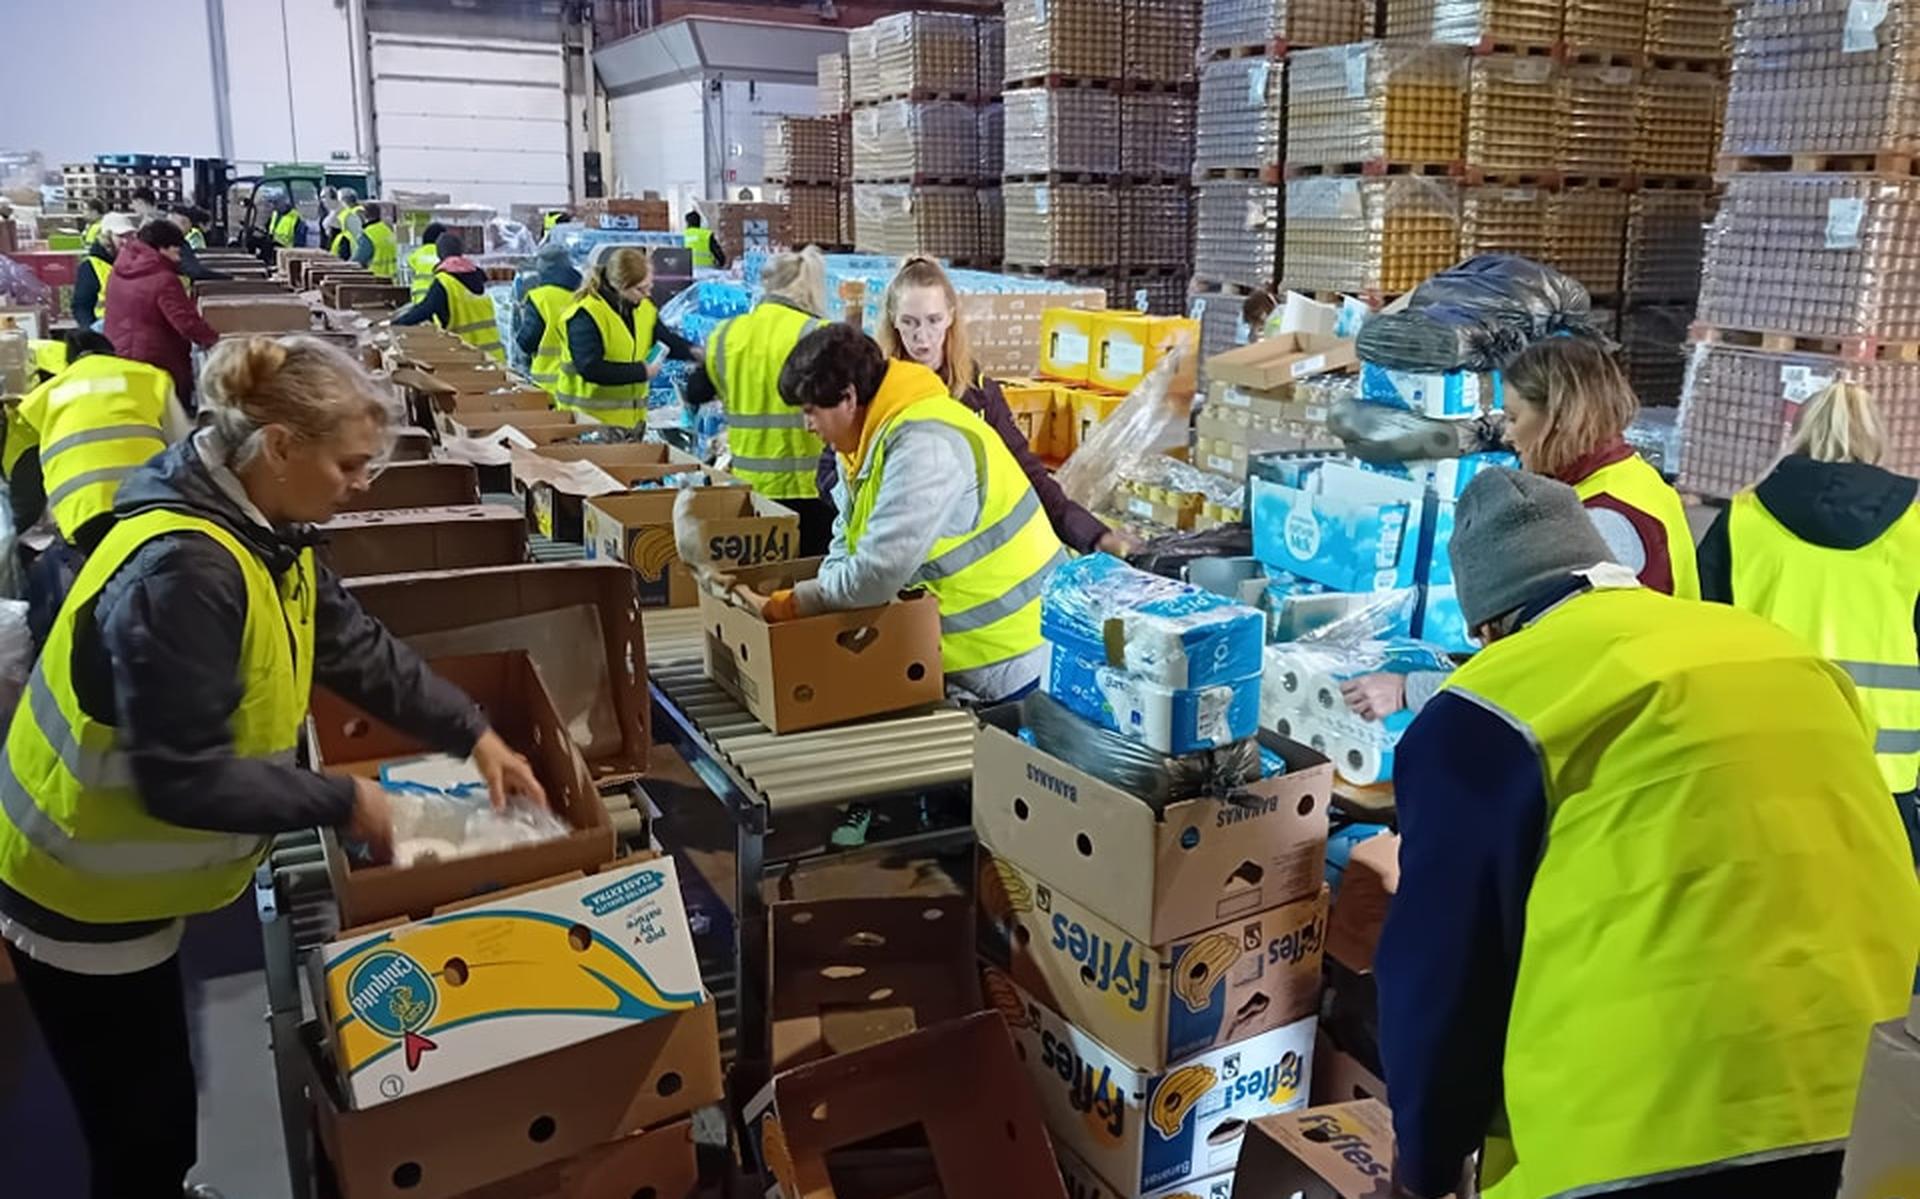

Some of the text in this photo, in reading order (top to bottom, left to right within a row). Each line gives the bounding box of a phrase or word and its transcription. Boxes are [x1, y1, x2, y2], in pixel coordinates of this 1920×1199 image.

[709, 525, 790, 567] Fyffes
[1026, 763, 1078, 803] BANANAS
[351, 955, 414, 1012] Chiquita
[1050, 911, 1150, 1012] Fyffes
[1042, 1033, 1123, 1137] Fyffes
